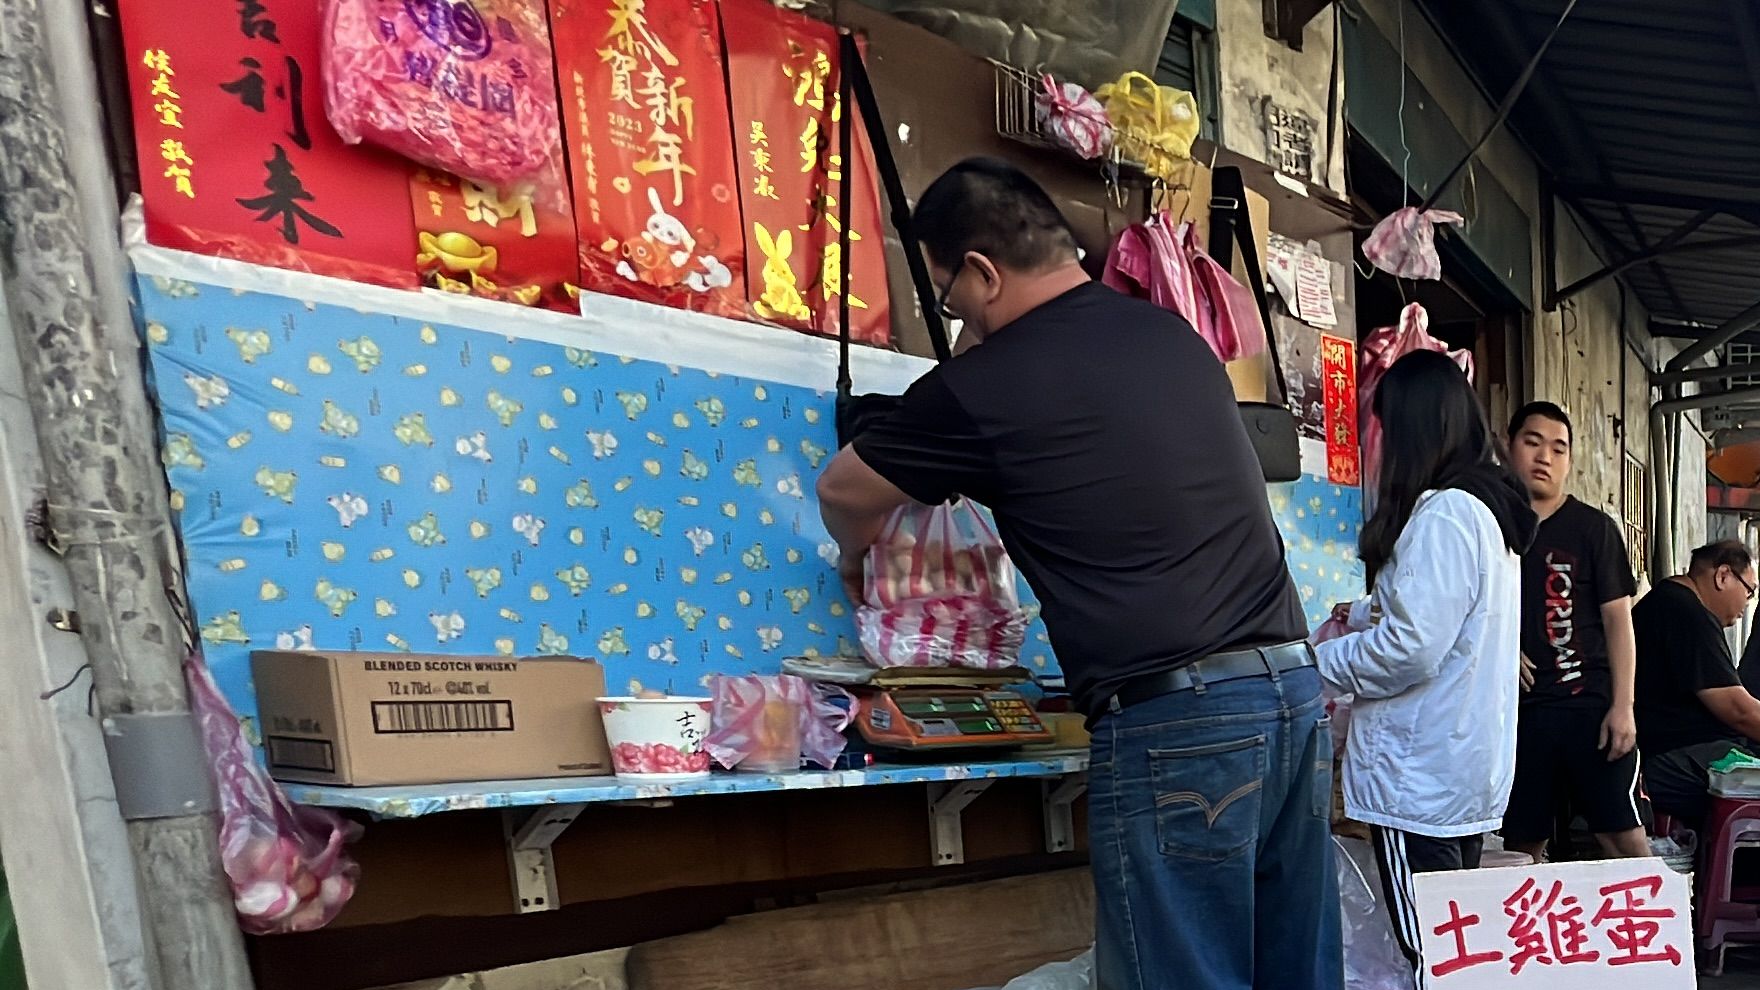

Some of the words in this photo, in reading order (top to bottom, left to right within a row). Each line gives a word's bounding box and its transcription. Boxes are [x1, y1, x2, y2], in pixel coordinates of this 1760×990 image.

[607, 112, 643, 133] 2023
[160, 138, 195, 199] 敬賀
[1545, 551, 1583, 684] JORDAN
[364, 660, 422, 671] BLENDED
[425, 661, 472, 672] SCOTCH
[475, 662, 518, 672] WHISKY
[388, 681, 401, 695] 12
[1430, 874, 1682, 977] 土雞蛋
